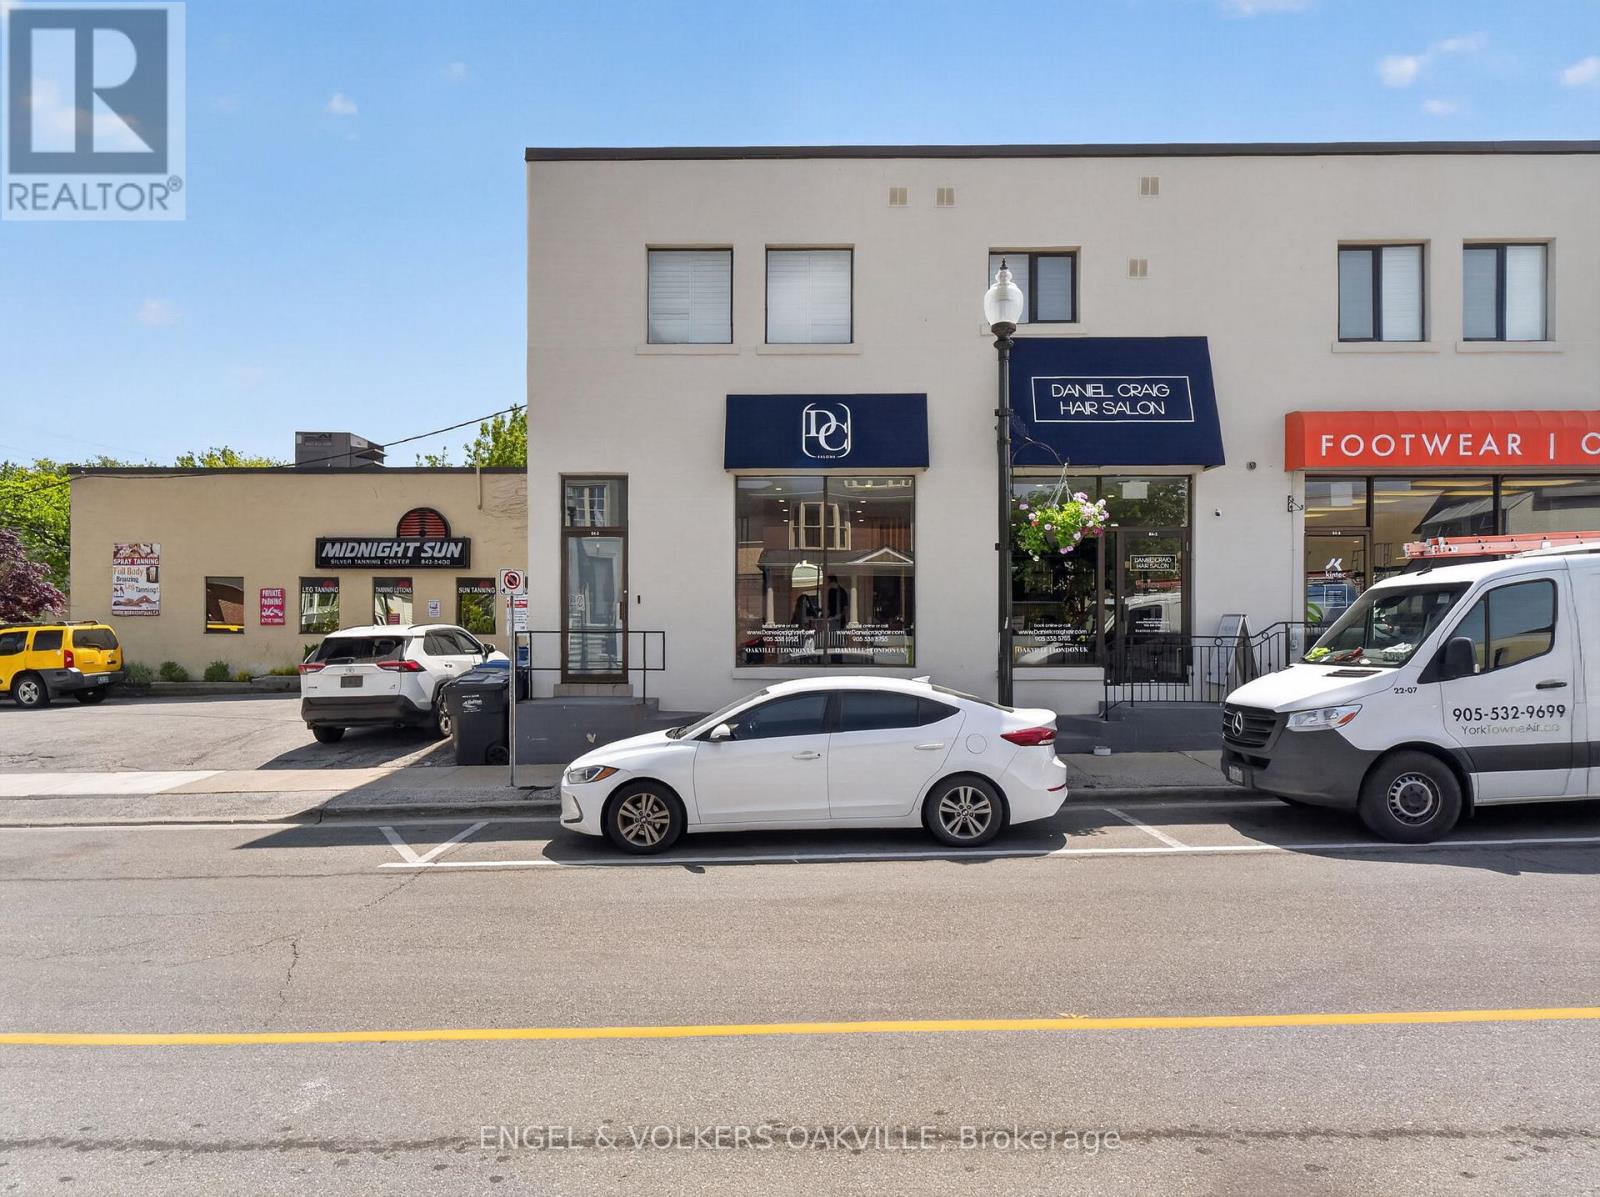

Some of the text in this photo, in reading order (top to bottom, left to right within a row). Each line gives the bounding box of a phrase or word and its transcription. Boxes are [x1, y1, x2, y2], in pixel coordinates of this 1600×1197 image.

[1051, 384, 1170, 398] DANIEL CRAIG
[1060, 401, 1165, 415] HAIR SALON
[1320, 433, 1523, 457] FOOTWEAR
[321, 542, 463, 558] MIDNIGHT SUN
[127, 567, 144, 577] Body
[1325, 570, 1347, 578] kintec
[1452, 704, 1566, 722] 905-532-9699
